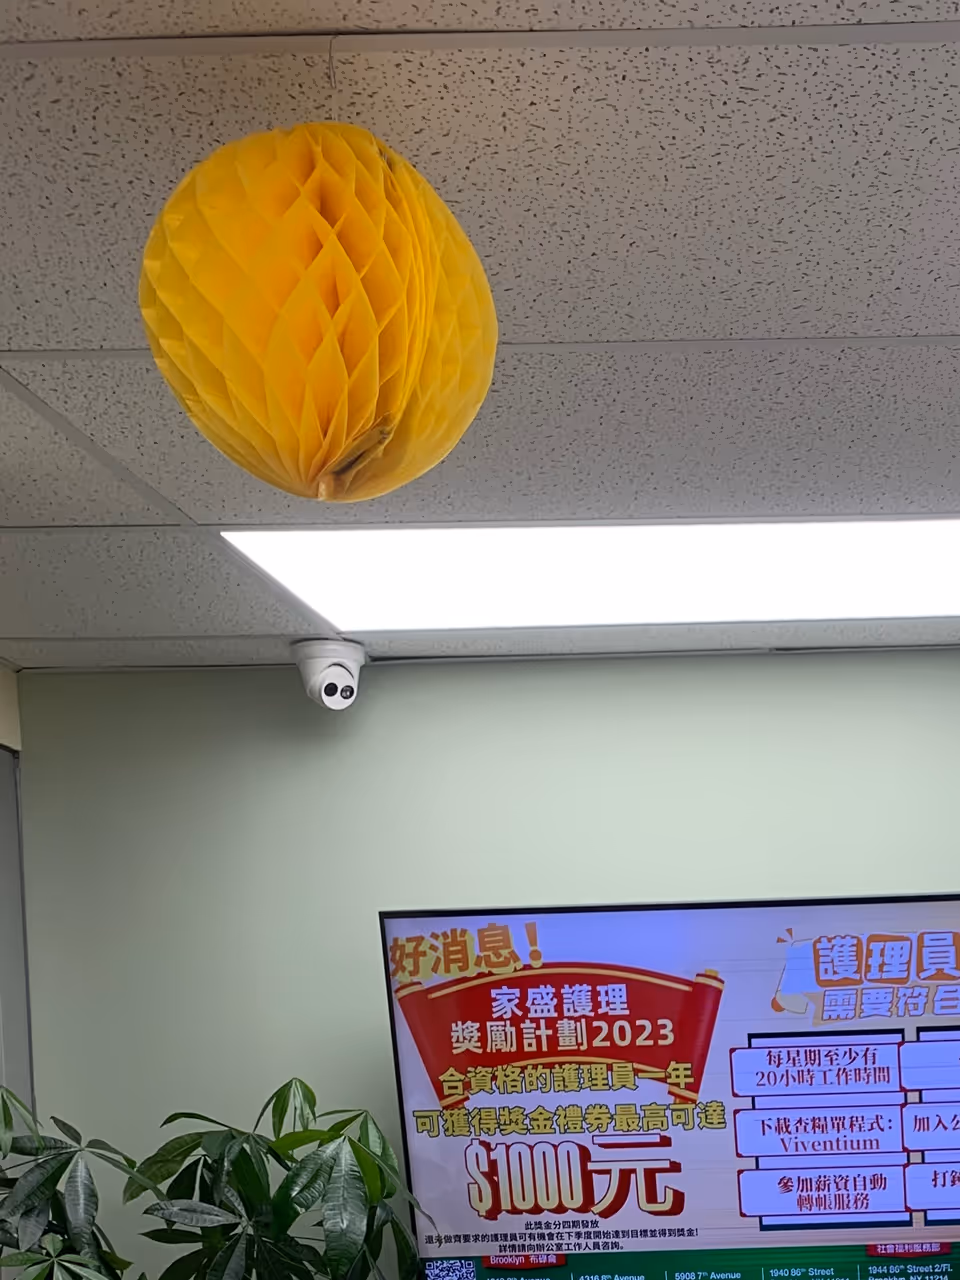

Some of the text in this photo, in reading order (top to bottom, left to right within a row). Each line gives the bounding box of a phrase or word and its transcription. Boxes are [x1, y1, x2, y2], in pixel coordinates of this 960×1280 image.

[390, 921, 542, 977] 好消息!
[490, 983, 630, 1019] 家盛護理
[451, 1018, 675, 1055] 獎勵計劃2023
[766, 1047, 878, 1068] 每星期至少有
[439, 1061, 695, 1095] 合資格的護理員一年
[756, 1066, 890, 1087] 20小時工作時間
[413, 1100, 727, 1138] 可獲得獎金禮券最高可達
[756, 1115, 893, 1136] 下載查糧單程式:
[780, 1135, 880, 1152] Viventium
[465, 1133, 684, 1221] $1000元
[778, 1173, 887, 1194] 參加薪資自動
[797, 1193, 870, 1211] 轉帳服務
[525, 1219, 599, 1230] 此獎金分四期發放
[490, 1254, 525, 1266] Brooklyn
[868, 1265, 887, 1274] 1944
[906, 1264, 933, 1273] Street
[675, 1272, 695, 1280] 5908
[710, 1271, 741, 1280] Avenue
[769, 1269, 789, 1277] 1940
[808, 1268, 835, 1276] Street
